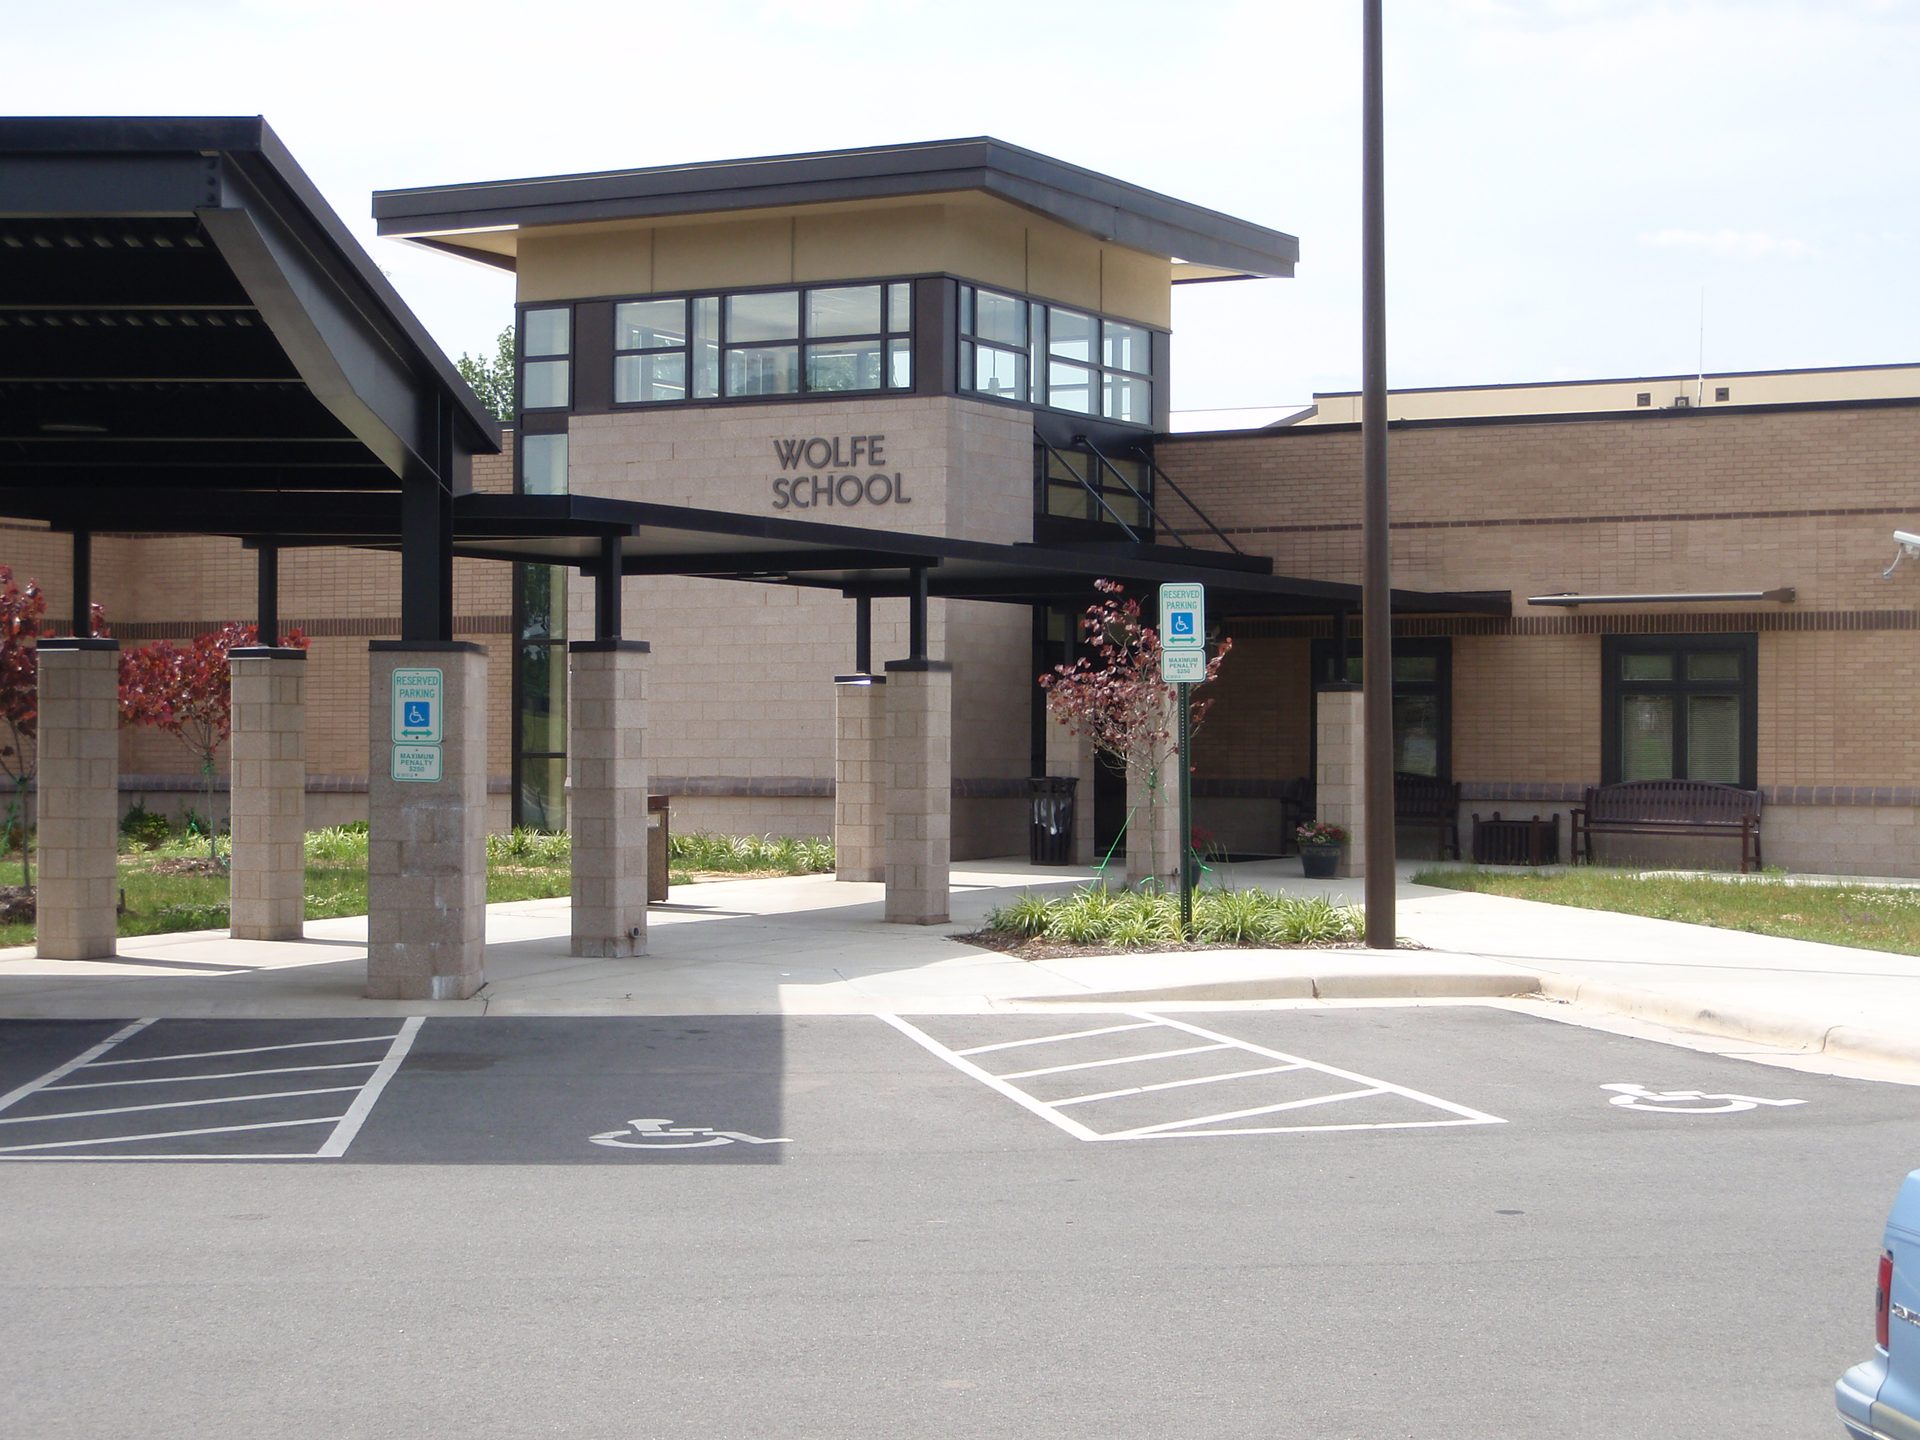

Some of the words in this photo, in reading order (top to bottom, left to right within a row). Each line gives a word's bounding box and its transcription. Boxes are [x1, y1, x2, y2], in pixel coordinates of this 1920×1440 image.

[773, 434, 886, 470] WOLFE
[772, 472, 911, 509] SCHOOL
[1163, 590, 1199, 598] RESERVED
[1167, 601, 1197, 609] PARKING
[396, 676, 438, 685] RESERVED
[400, 688, 435, 698] PARKING
